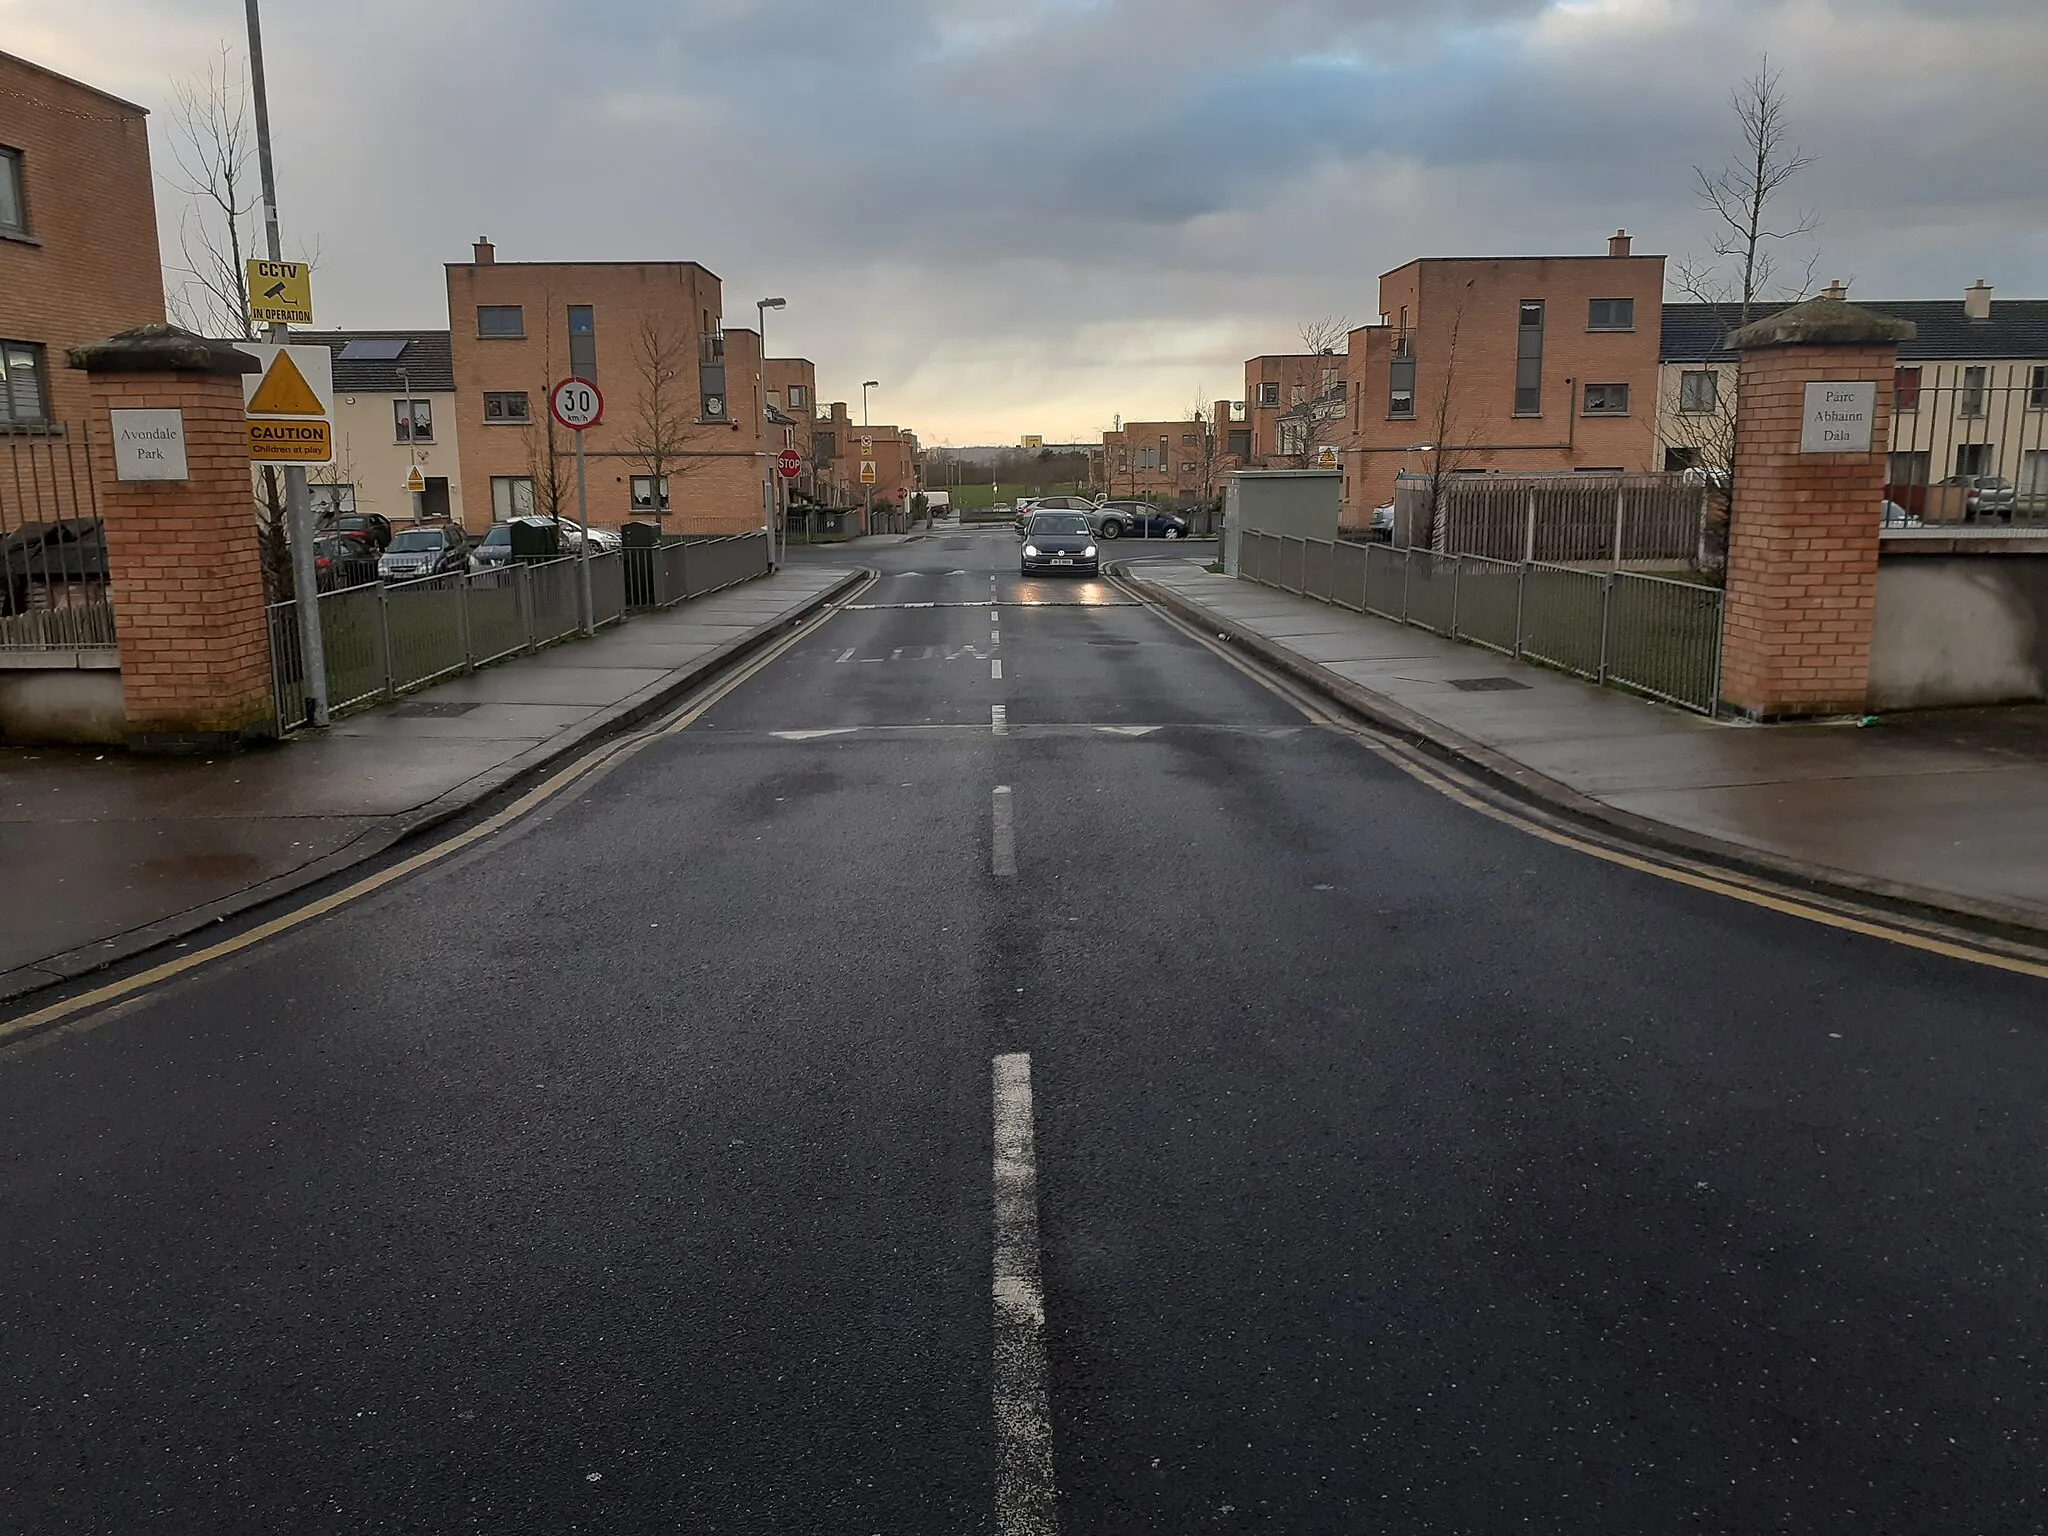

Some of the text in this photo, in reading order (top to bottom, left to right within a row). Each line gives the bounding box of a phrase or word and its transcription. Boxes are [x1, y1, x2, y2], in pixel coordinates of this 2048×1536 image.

[258, 262, 297, 279] CCTV
[253, 308, 311, 322] IN OPERATION
[564, 389, 590, 412] 30
[1825, 390, 1855, 402] Páirc
[567, 414, 589, 422] km/h
[1814, 410, 1863, 422] Abhainn
[120, 427, 177, 440] Avondale
[250, 426, 324, 440] CAUTION
[1824, 429, 1850, 442] Dála
[137, 447, 165, 460] Park
[252, 444, 322, 455] Children at play
[778, 458, 800, 469] STOP
[792, 643, 998, 664] LOW
